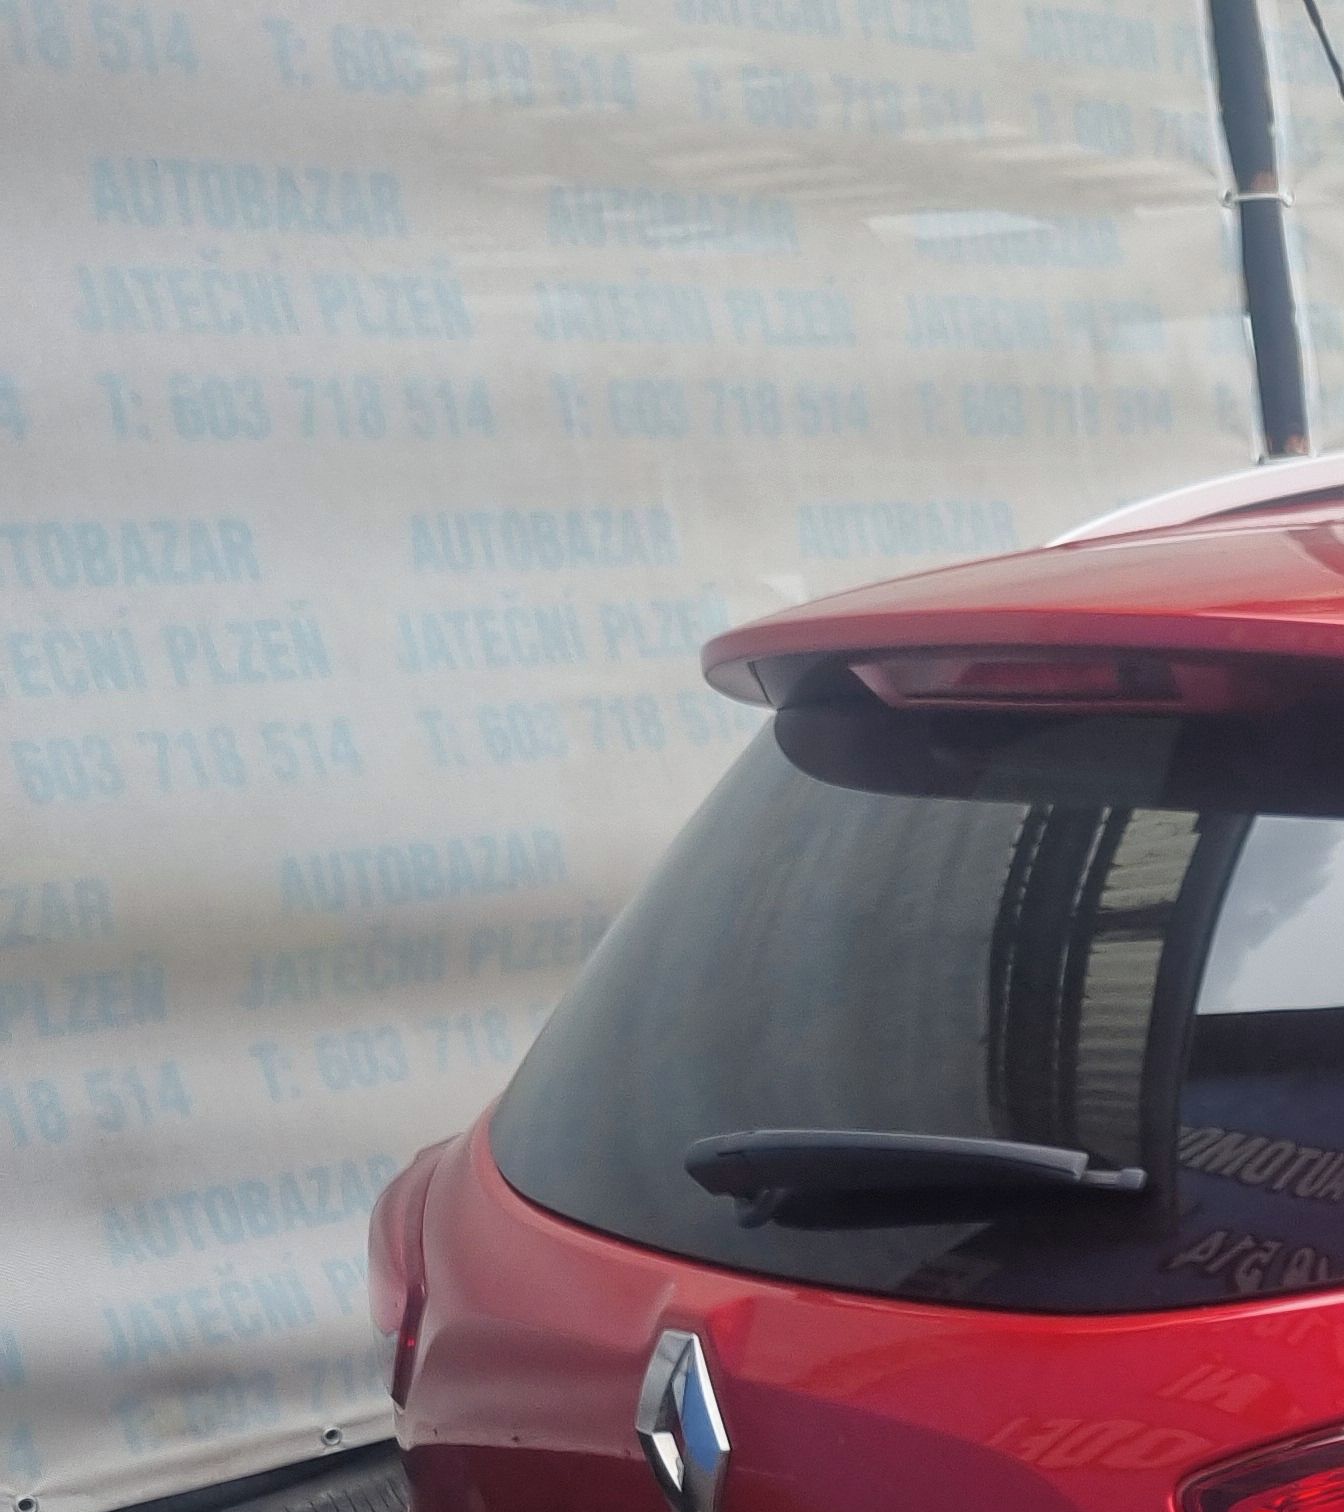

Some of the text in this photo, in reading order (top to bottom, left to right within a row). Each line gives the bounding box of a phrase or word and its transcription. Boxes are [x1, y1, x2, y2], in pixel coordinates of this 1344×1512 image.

[331, 23, 426, 95] 603
[90, 157, 409, 238] AUTOBAZAR
[73, 249, 473, 341] JATEČNÍ PLZEŇ
[96, 372, 498, 444] T: 603 718 514
[608, 376, 690, 440] 603
[705, 380, 780, 438] 718
[794, 381, 871, 438] 514
[407, 503, 680, 573] AUTOBAZAR
[0, 598, 334, 698] EČNÍ PLZEŇ
[396, 586, 589, 676] JATEČNÍ
[10, 711, 364, 804] 603 718 514
[476, 698, 569, 766] 603
[580, 689, 668, 752] 718
[278, 823, 568, 909] AUTOBAZAR
[313, 1022, 409, 1094] 603
[424, 1005, 514, 1074] 718
[84, 1058, 194, 1134] 514
[100, 1261, 315, 1372] JATEČNÍ
